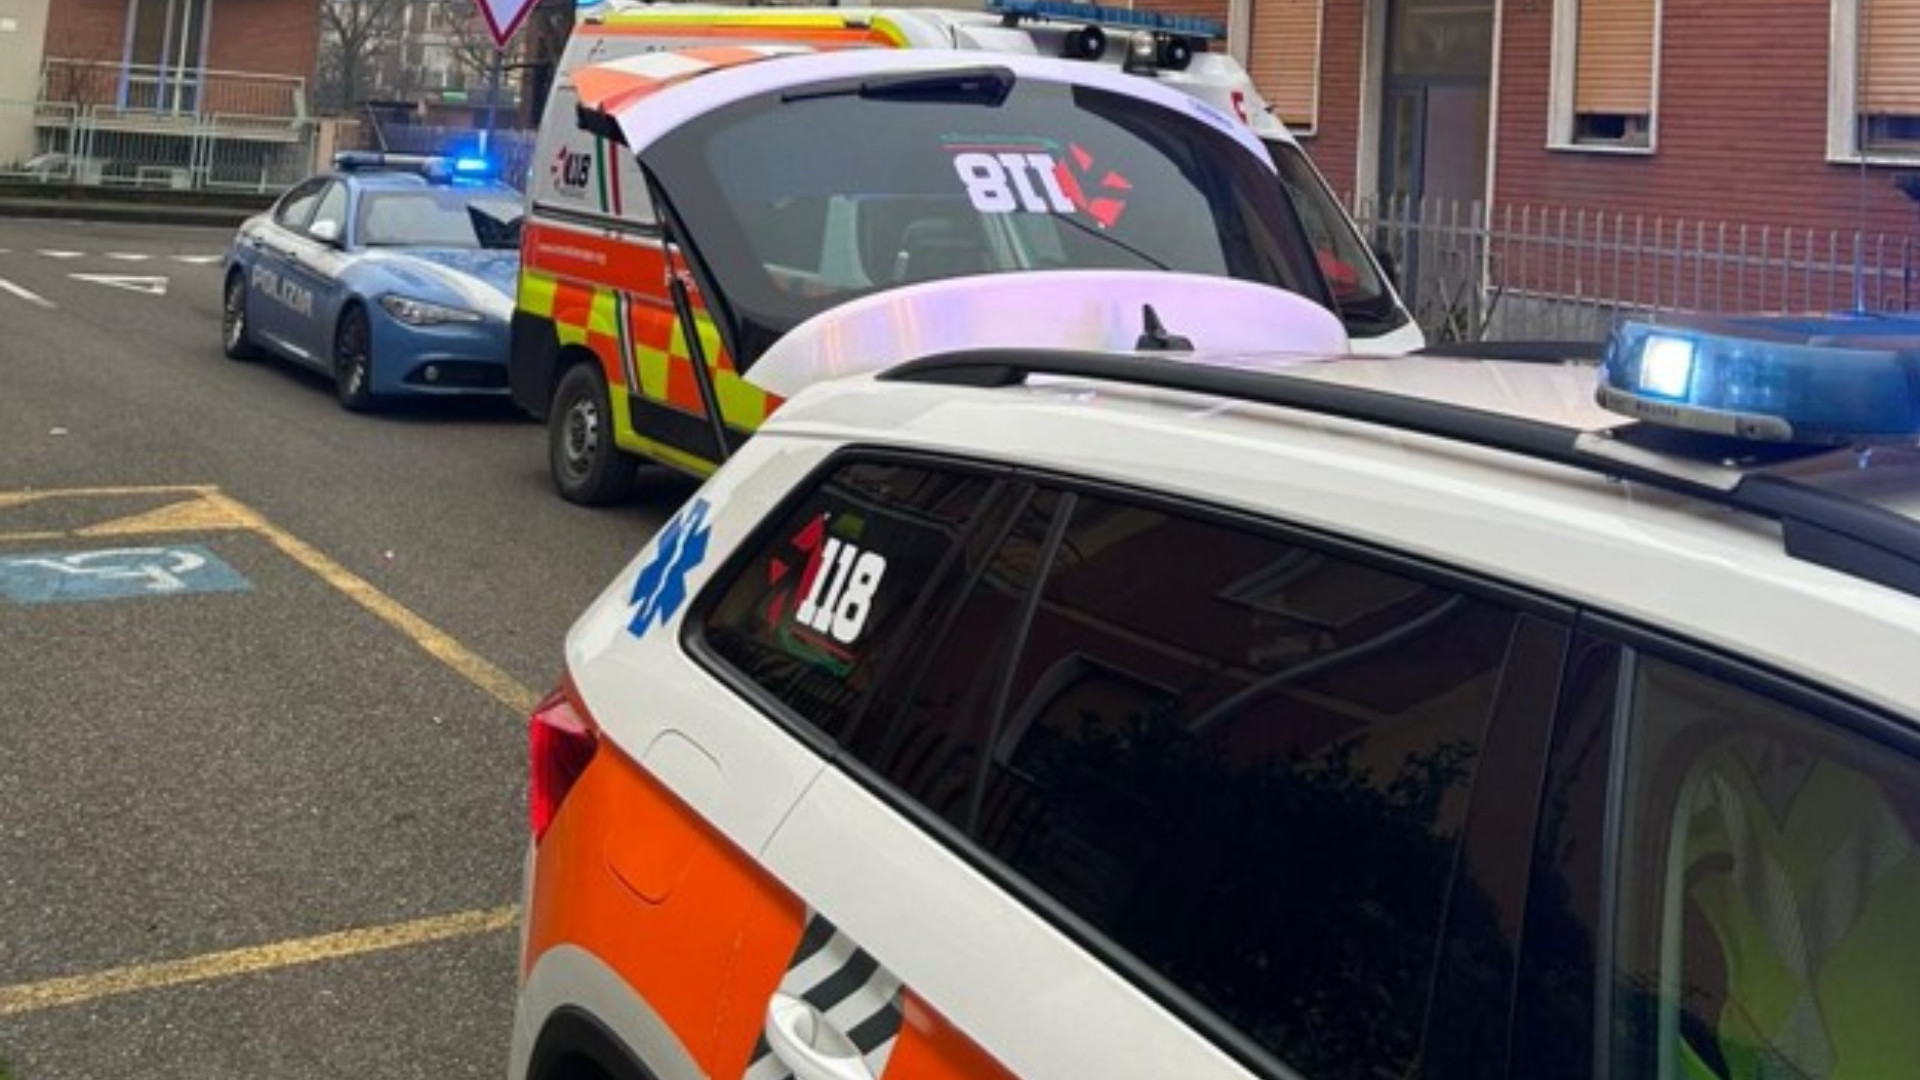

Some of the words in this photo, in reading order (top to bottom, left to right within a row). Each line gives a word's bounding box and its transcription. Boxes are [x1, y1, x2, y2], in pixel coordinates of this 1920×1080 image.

[563, 152, 592, 188] 118
[953, 152, 1077, 214] 118
[251, 264, 313, 318] POLIZIA
[796, 536, 887, 643] 118
